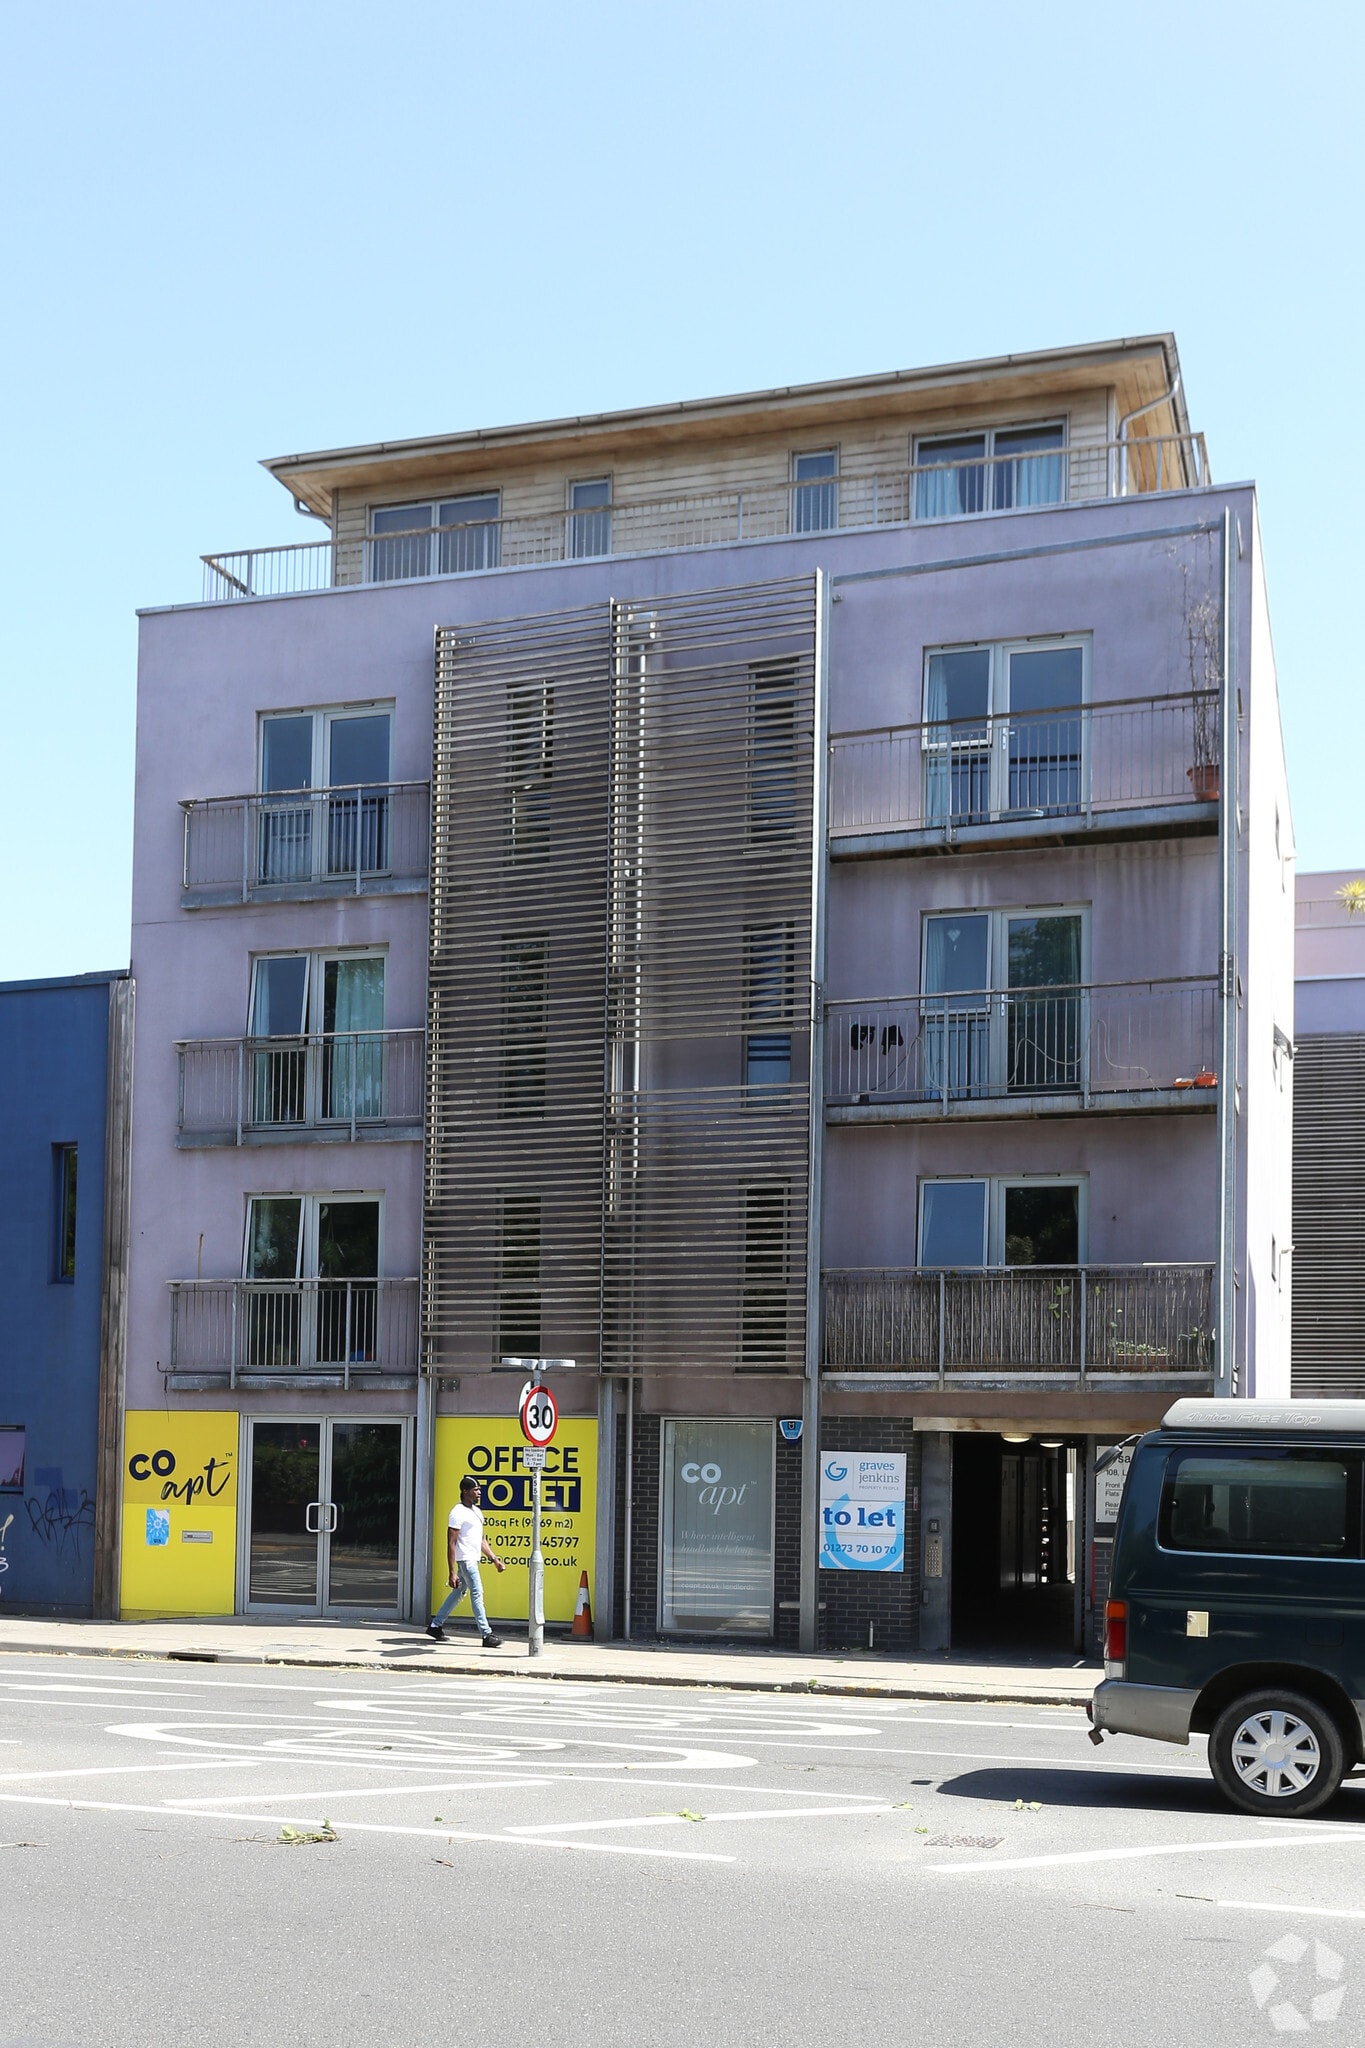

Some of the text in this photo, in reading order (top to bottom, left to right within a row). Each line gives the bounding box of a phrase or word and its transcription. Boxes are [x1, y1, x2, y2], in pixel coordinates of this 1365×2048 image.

[529, 1405, 553, 1429] 30
[1176, 1411, 1231, 1423] Auto
[1284, 1412, 1321, 1426] Top
[467, 1446, 578, 1473] OFFCE
[858, 1461, 895, 1472] graves
[160, 1457, 231, 1506] apt
[858, 1472, 900, 1484] jenkins
[699, 1484, 749, 1515] apt
[510, 1518, 519, 1527] Ft
[554, 1519, 573, 1529] m2)
[823, 1507, 896, 1527] to let
[495, 1535, 531, 1547] 01273
[540, 1536, 579, 1548] 45797
[823, 1543, 897, 1555] 01273 70 10 70
